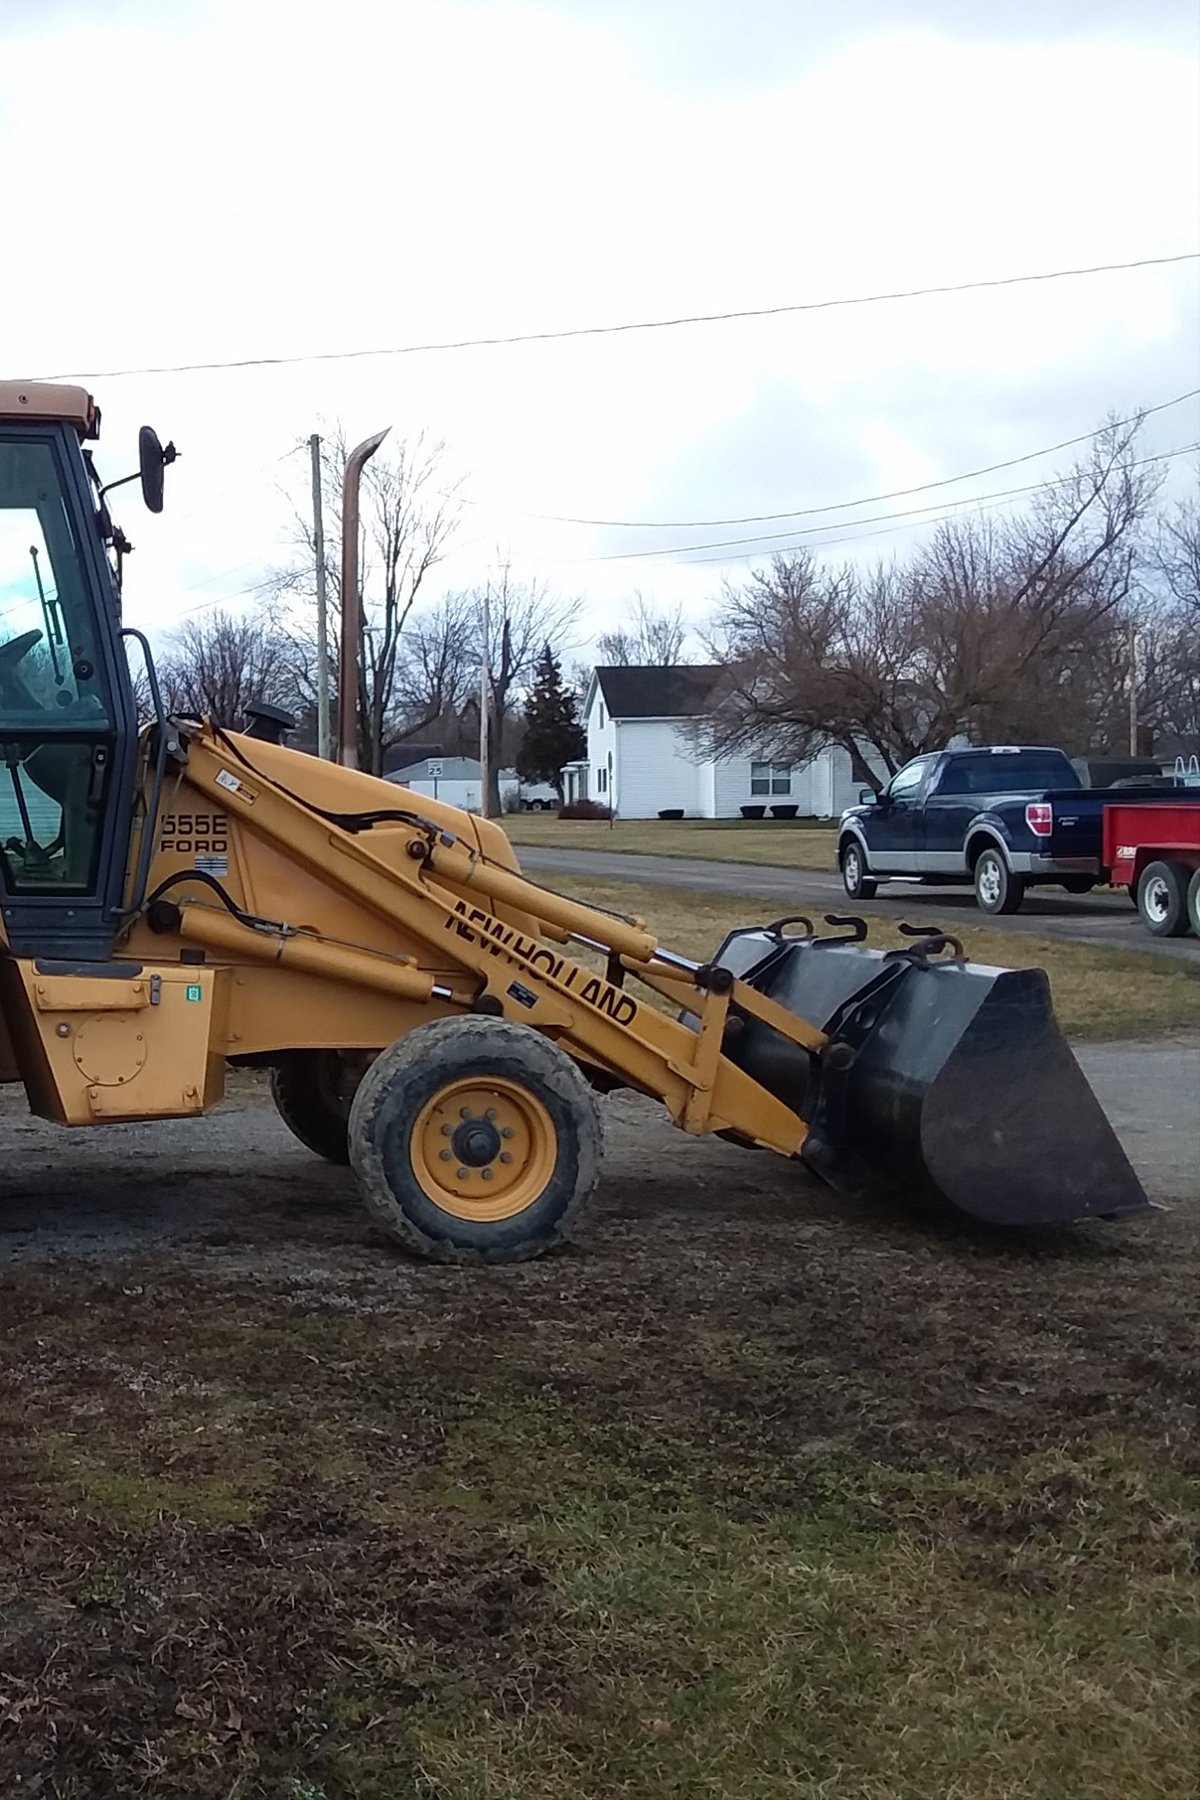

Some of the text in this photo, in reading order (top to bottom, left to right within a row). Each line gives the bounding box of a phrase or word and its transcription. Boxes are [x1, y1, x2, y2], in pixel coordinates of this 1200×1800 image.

[429, 767, 442, 775] 25
[161, 815, 228, 835] 555E
[161, 840, 227, 852] FORD
